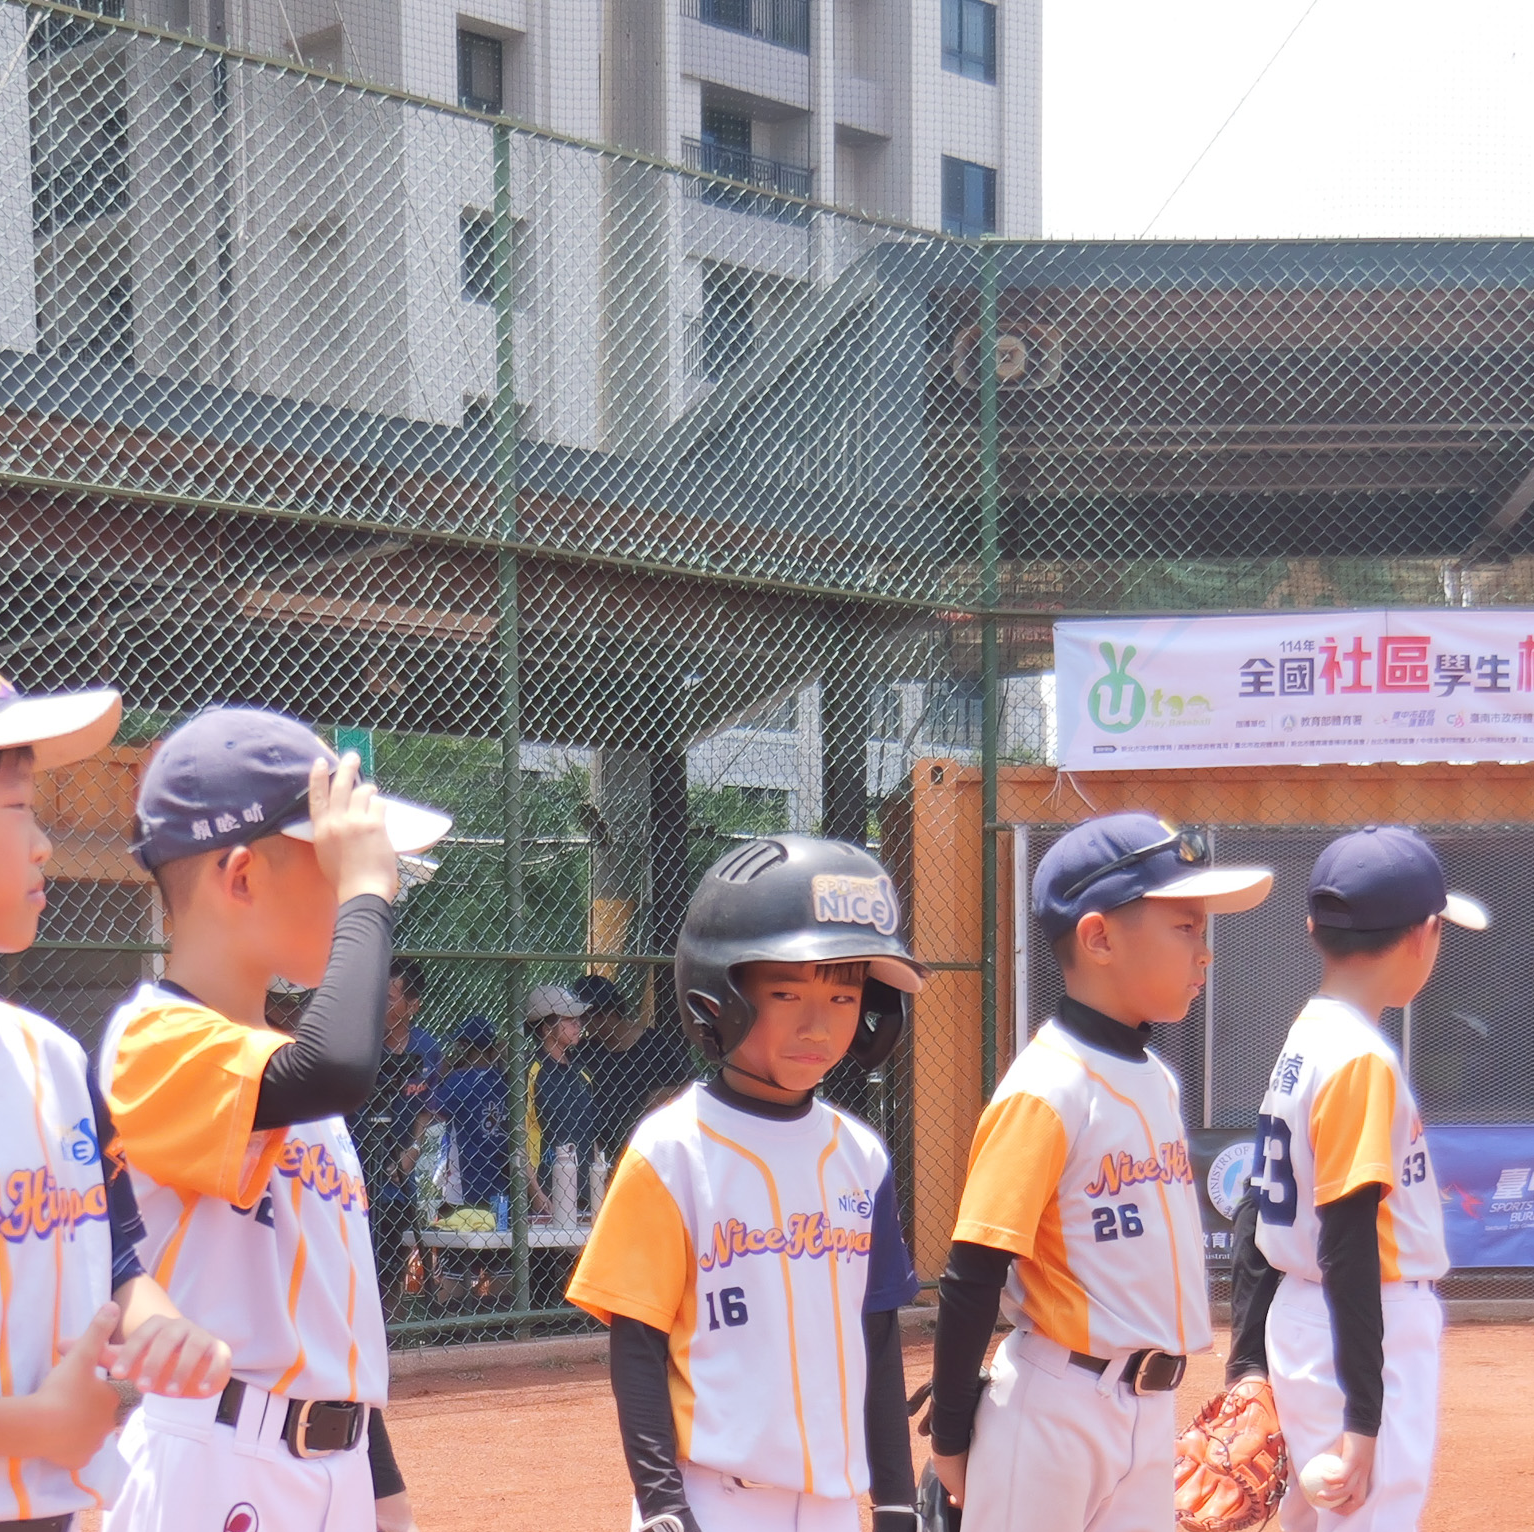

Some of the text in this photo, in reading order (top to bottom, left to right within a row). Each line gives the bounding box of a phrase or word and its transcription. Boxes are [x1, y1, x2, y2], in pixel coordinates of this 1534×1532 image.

[1279, 639, 1316, 653] 114年
[1300, 715, 1364, 728] 教育部體育署
[1209, 1151, 1233, 1206] MINISTRY
[1234, 1145, 1250, 1157] OF
[1489, 1200, 1534, 1213] SPORTS
[1091, 1203, 1144, 1243] 26
[705, 1286, 749, 1332] 16
